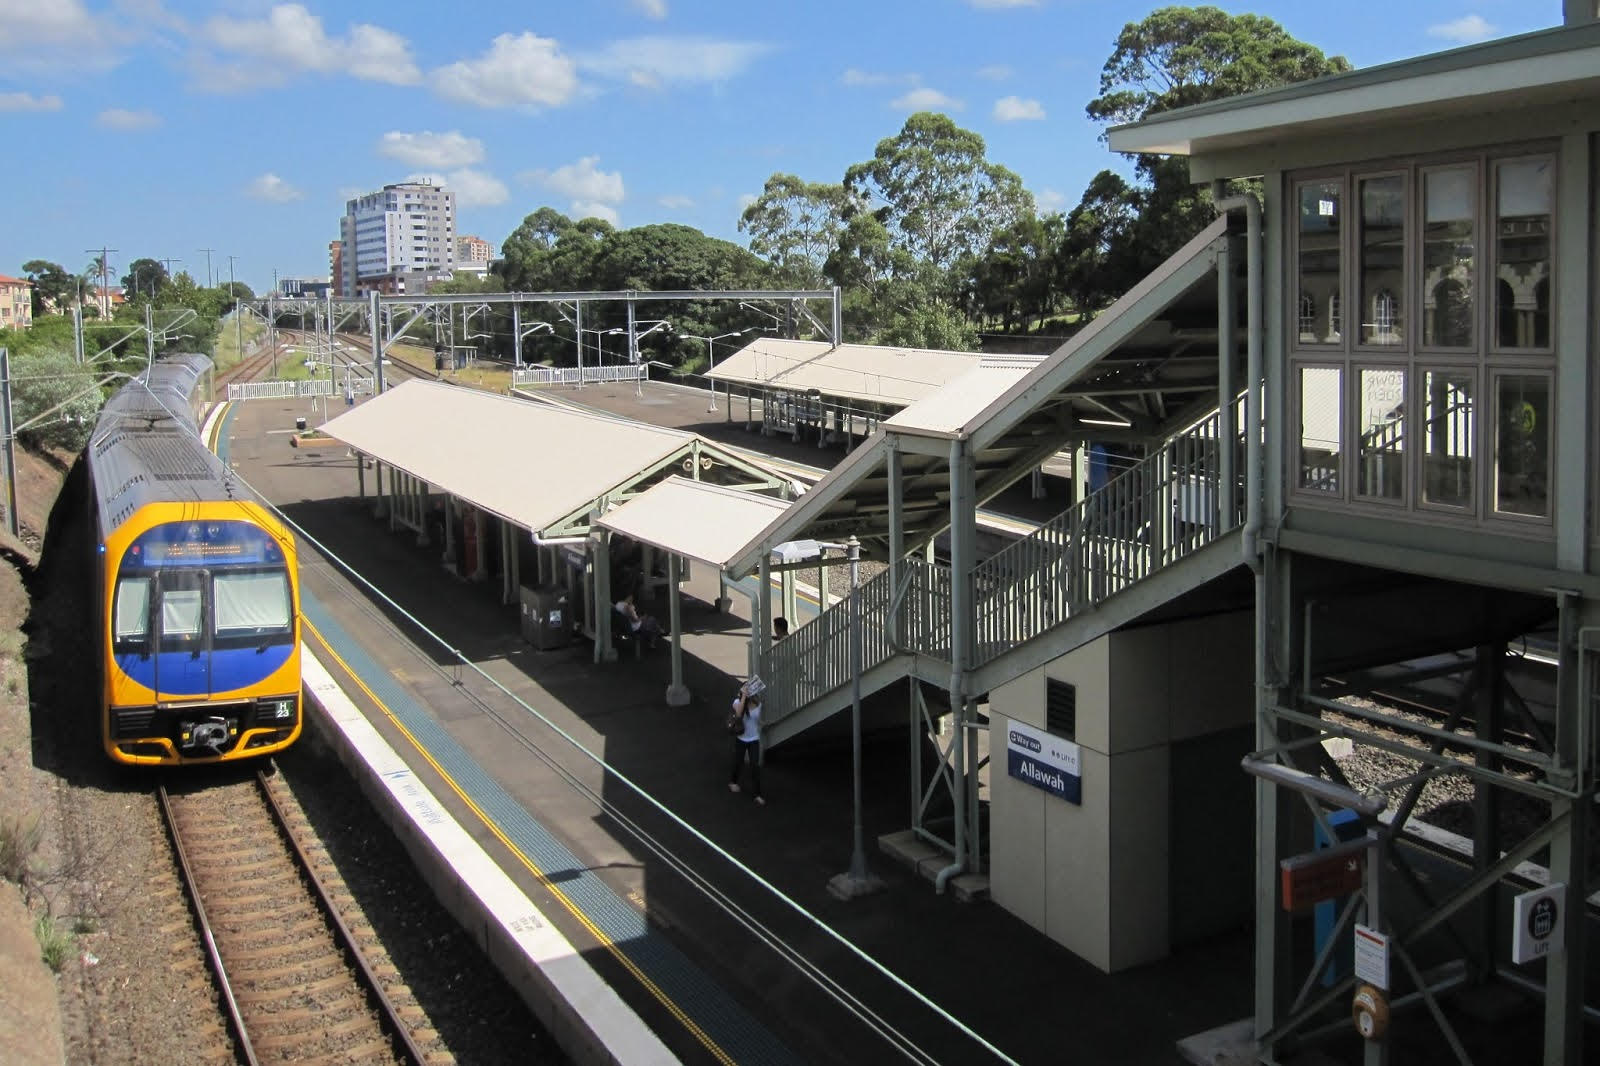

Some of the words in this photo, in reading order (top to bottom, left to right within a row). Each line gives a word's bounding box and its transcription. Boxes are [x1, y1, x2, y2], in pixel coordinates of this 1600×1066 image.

[276, 709, 289, 718] 23
[1016, 734, 1030, 747] Way
[1030, 741, 1041, 751] out
[1020, 761, 1065, 791] Allawah
